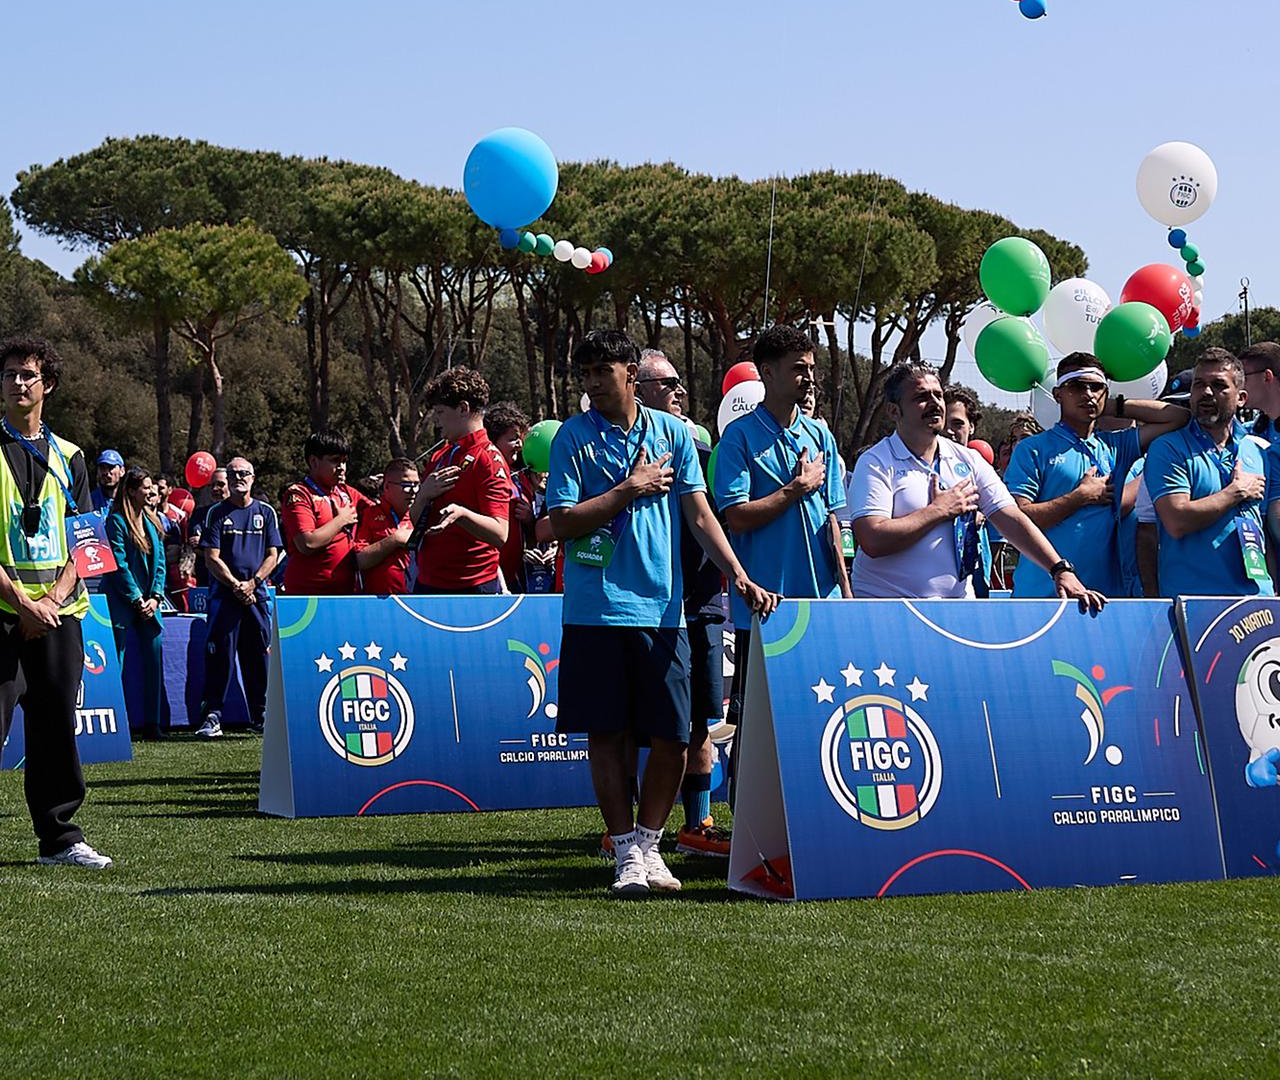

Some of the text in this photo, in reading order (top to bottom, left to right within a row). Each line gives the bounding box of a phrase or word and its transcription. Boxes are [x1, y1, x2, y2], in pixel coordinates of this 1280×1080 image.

[732, 396, 745, 404] #IL
[732, 404, 756, 412] CALC
[576, 551, 603, 561] SQUADRA
[1240, 609, 1274, 635] KIAMO
[342, 700, 390, 722] FIGC
[358, 723, 377, 731] ITALIA
[531, 733, 568, 747] FIGC
[500, 752, 534, 763] CALCIO
[850, 740, 911, 772] FIGC
[872, 772, 896, 783] ITALIA
[1091, 786, 1137, 804] FIGC
[1053, 807, 1180, 825] CALCIO PARALIMPICO
